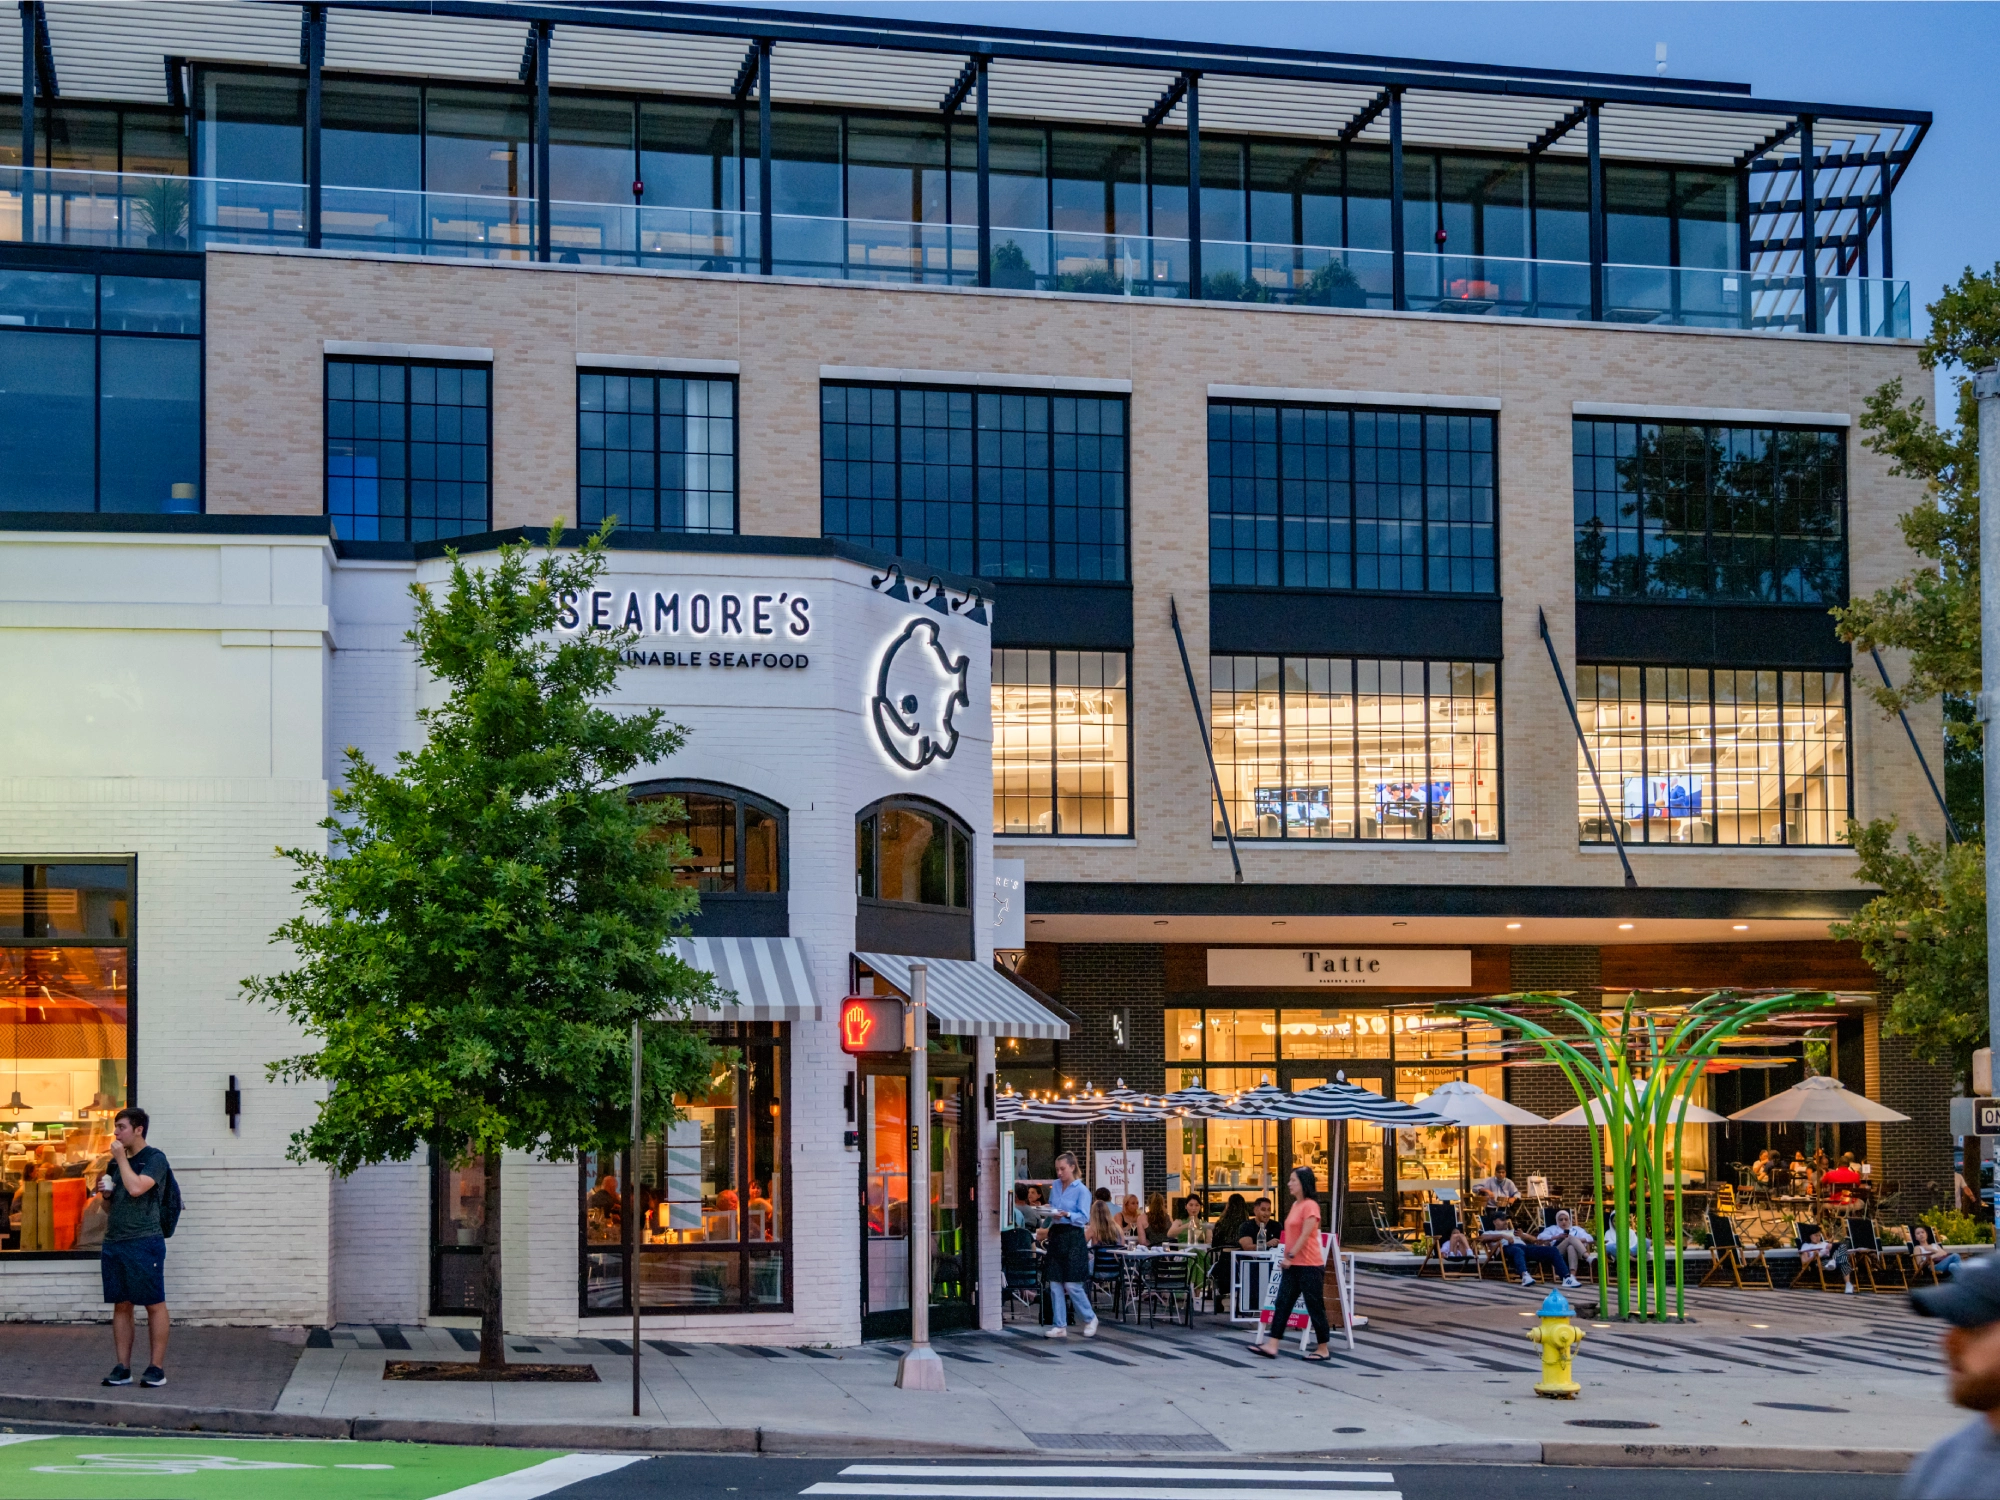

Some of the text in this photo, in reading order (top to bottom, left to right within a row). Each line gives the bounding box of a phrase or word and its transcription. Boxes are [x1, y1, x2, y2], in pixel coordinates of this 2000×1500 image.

[558, 591, 810, 636] SEAMORE'S
[619, 650, 809, 668] INABLE SEAFOOD
[1302, 952, 1380, 973] Tatte
[1105, 1163, 1134, 1174] Kissd
